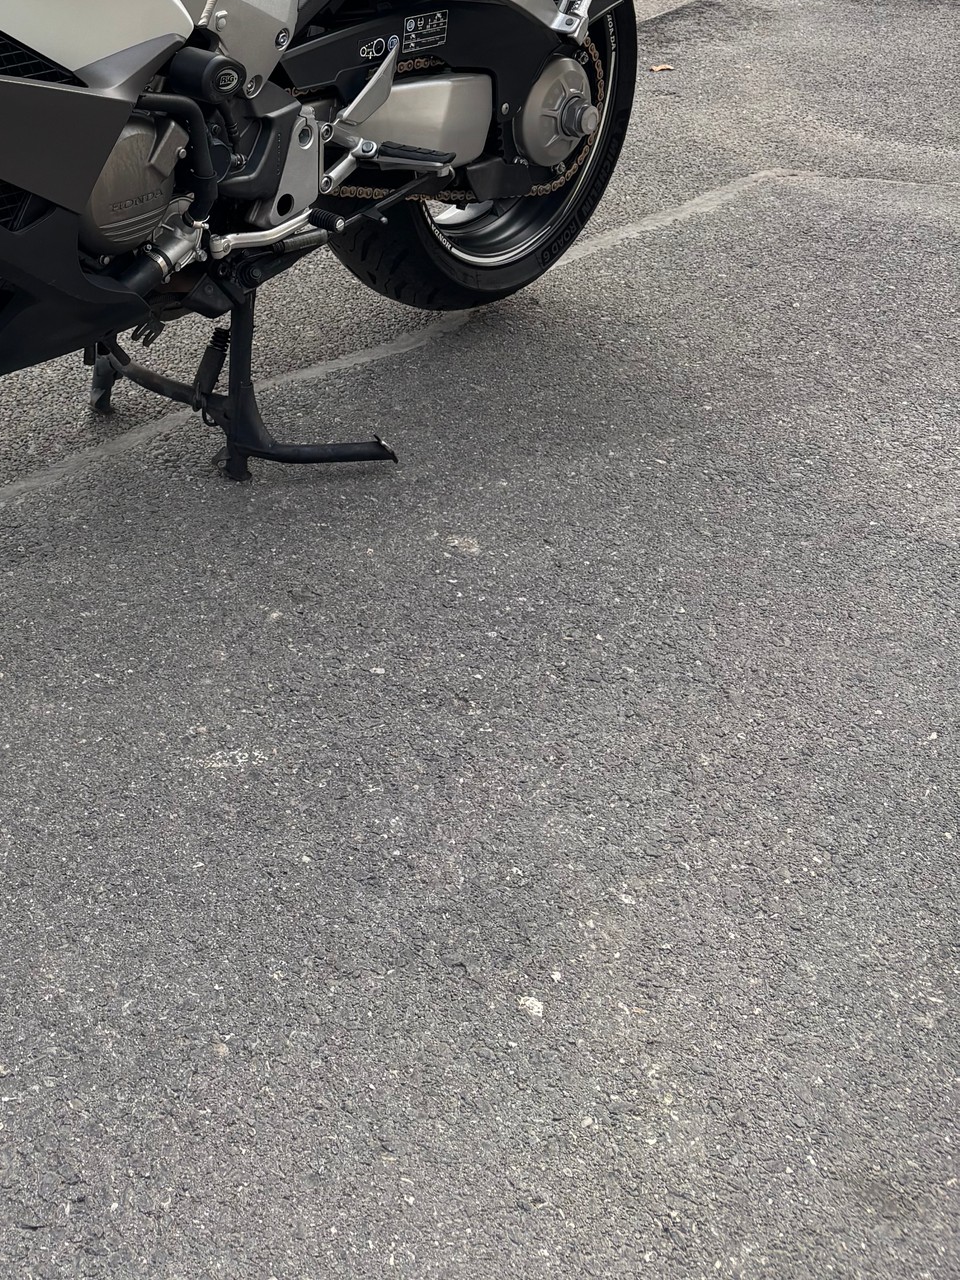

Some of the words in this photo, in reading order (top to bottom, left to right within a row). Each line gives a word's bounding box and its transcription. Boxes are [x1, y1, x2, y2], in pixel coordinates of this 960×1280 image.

[606, 14, 617, 51] HONDA
[581, 137, 618, 217] MICHELIN
[110, 190, 163, 212] HONDA
[431, 223, 452, 251] HONDA
[552, 222, 578, 252] ROAD
[542, 250, 551, 262] 6
